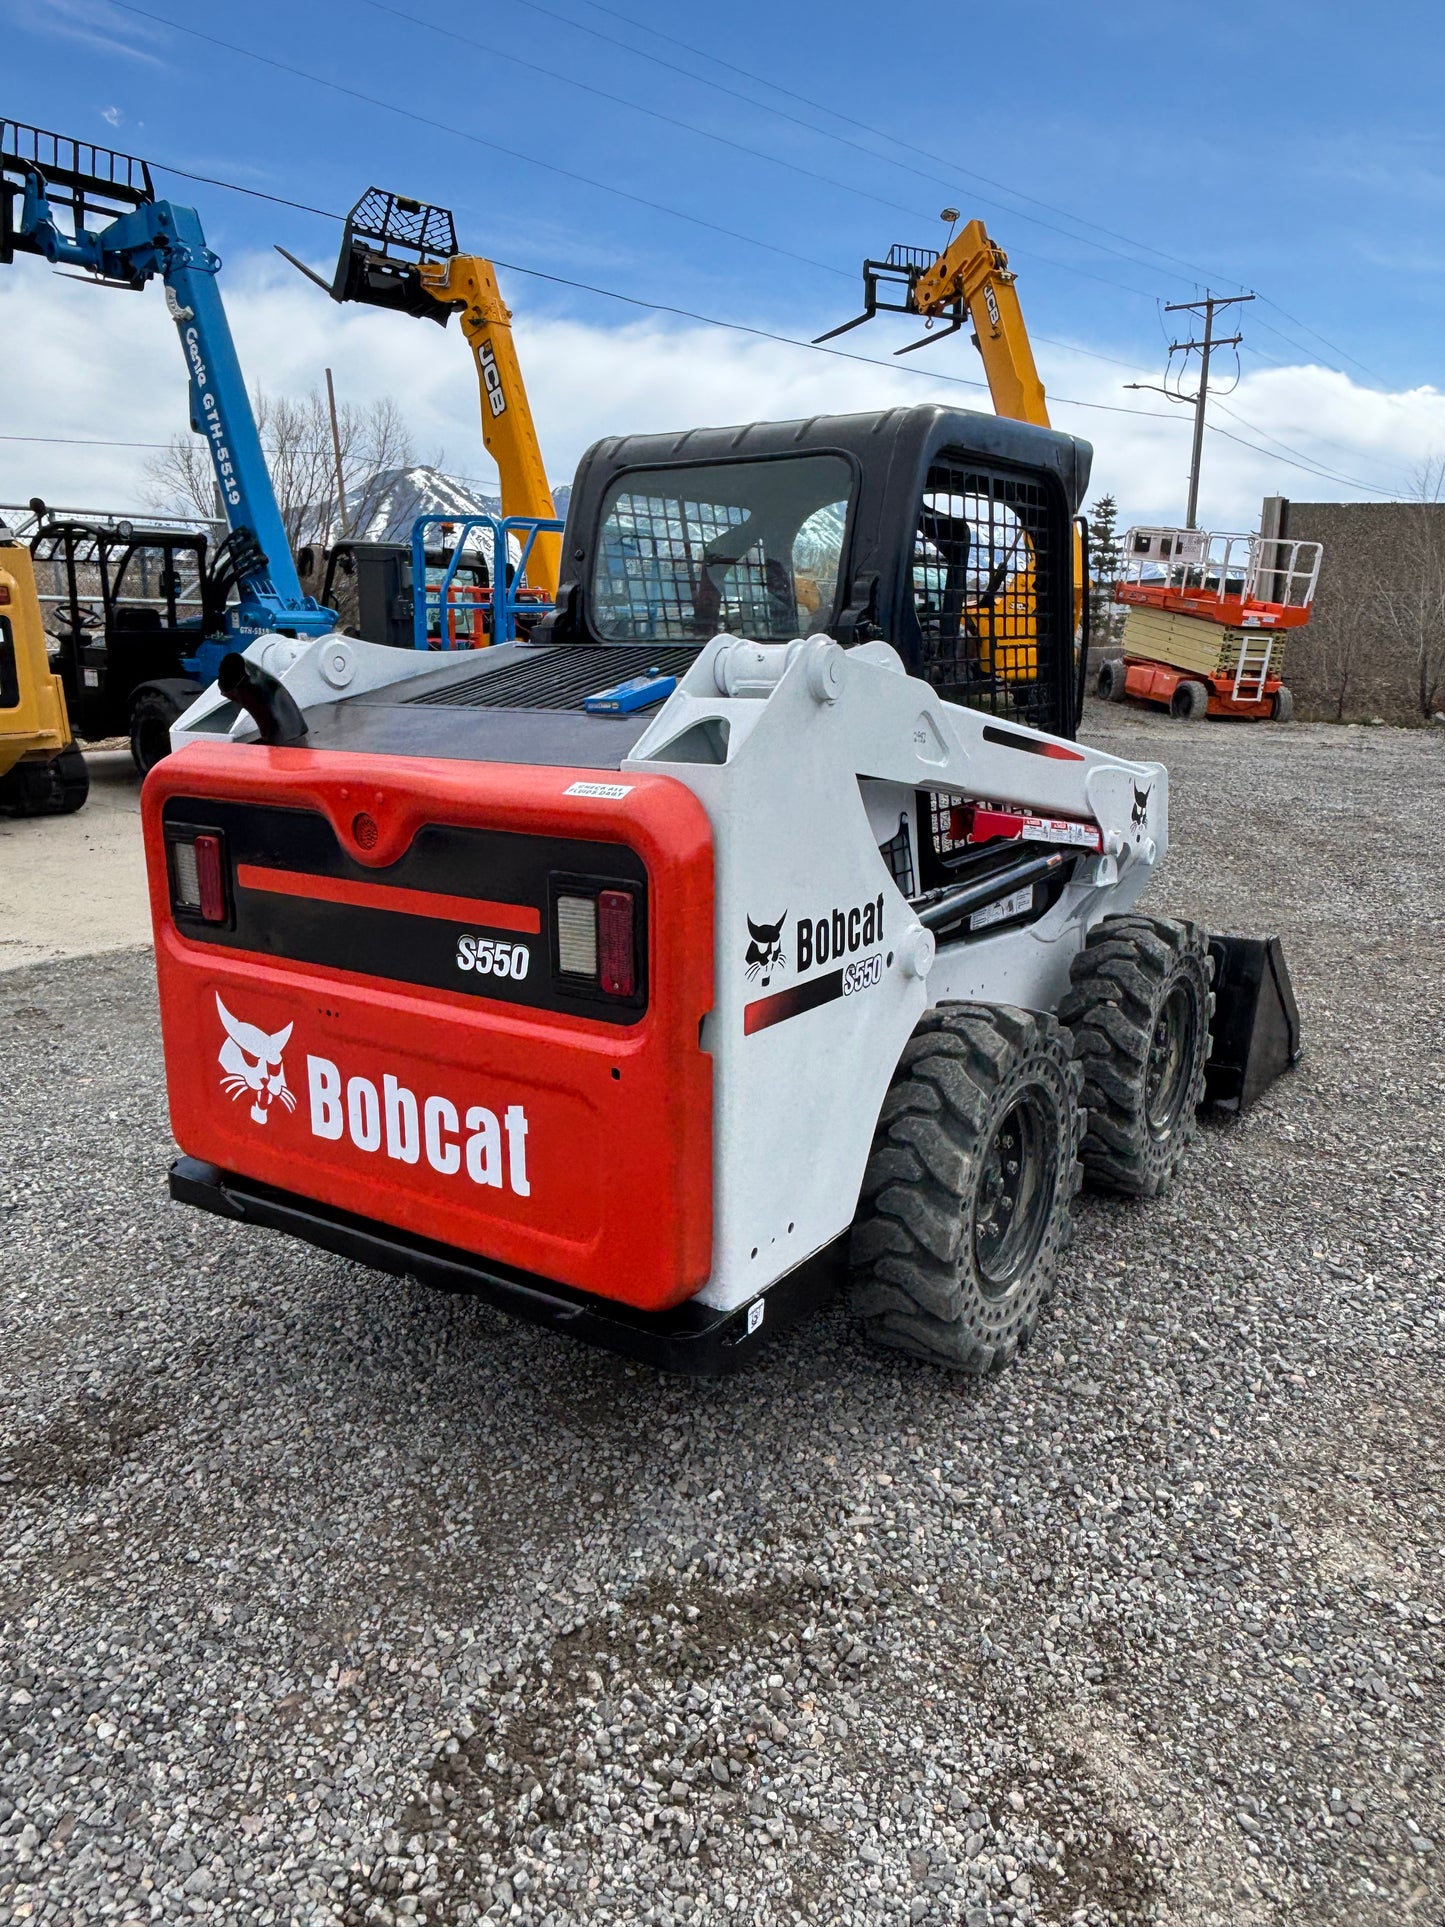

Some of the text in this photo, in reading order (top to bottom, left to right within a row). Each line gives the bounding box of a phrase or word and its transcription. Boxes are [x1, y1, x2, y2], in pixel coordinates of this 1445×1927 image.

[984, 286, 999, 325] JCB
[186, 327, 240, 505] Genie GTH-5519
[478, 345, 506, 416] JCB
[456, 934, 530, 980] S550
[797, 892, 884, 974] Bobcat
[843, 953, 882, 997] S550
[306, 1054, 531, 1197] Bobcat
